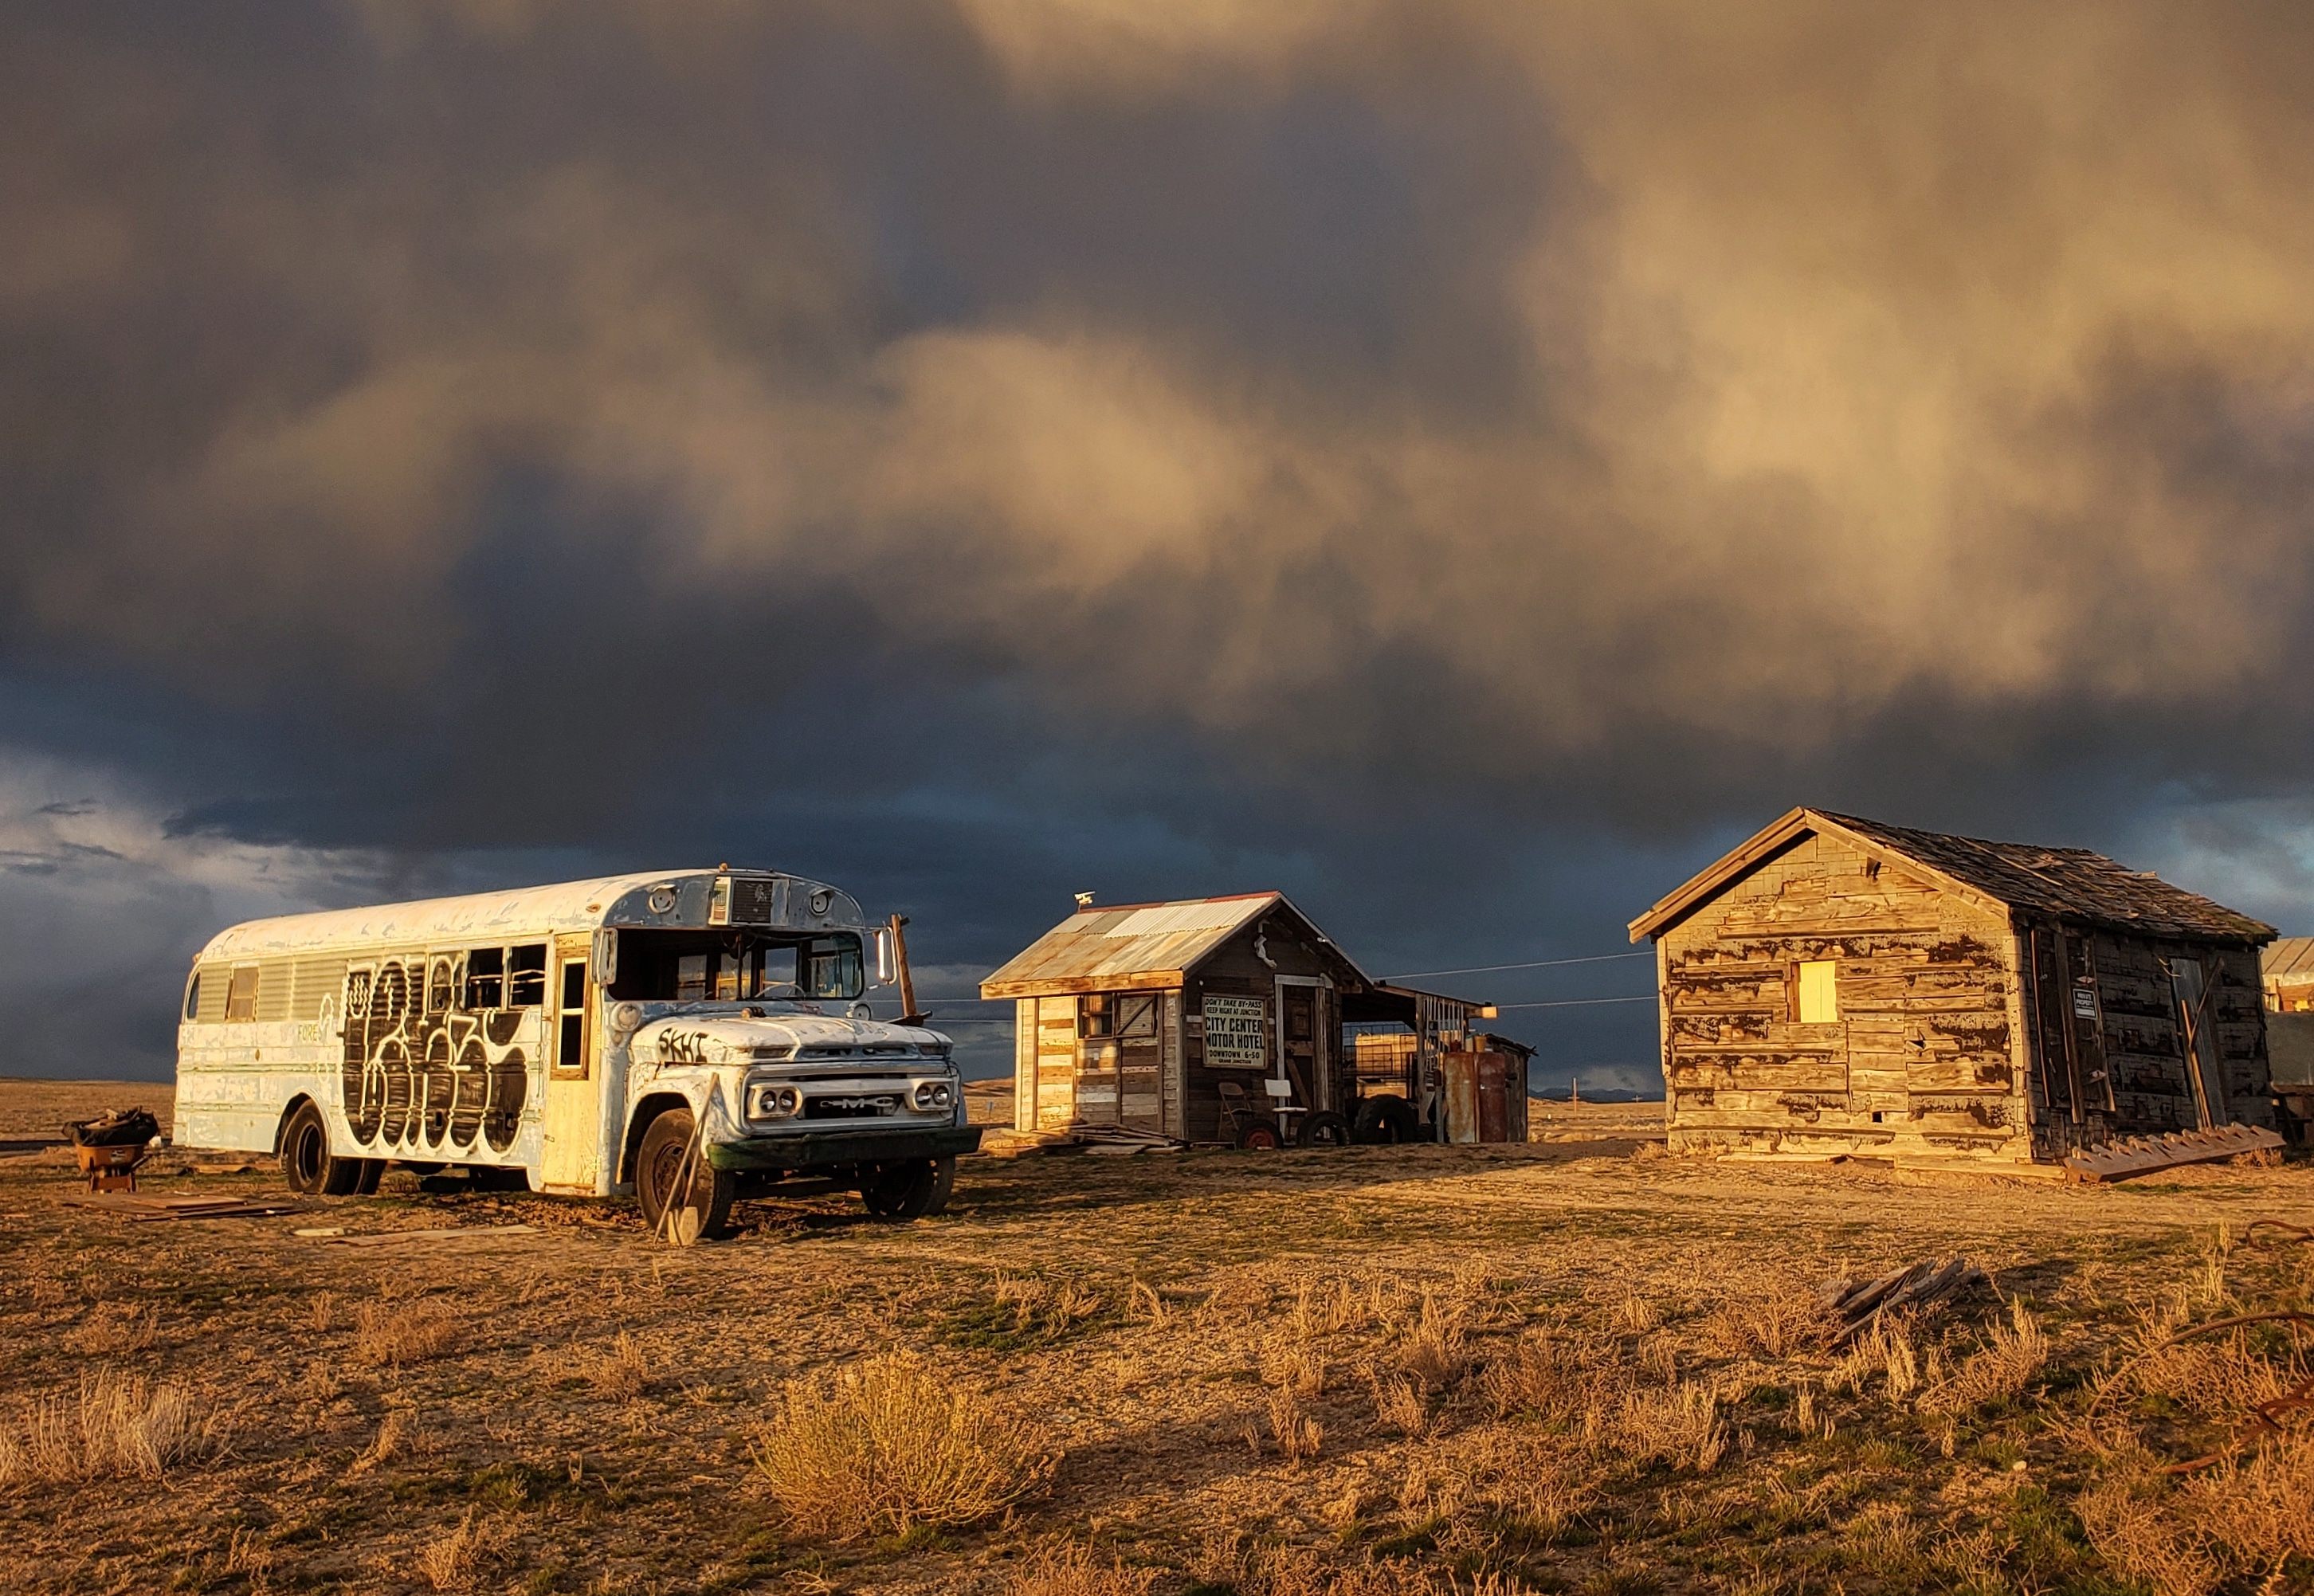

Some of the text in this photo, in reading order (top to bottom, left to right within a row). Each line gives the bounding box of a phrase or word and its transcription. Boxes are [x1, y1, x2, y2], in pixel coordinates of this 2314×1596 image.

[1205, 1017, 1264, 1033] CITY CENTER
[1237, 1034, 1265, 1049] HOTEL
[1209, 1049, 1241, 1058] DOWNTOWN
